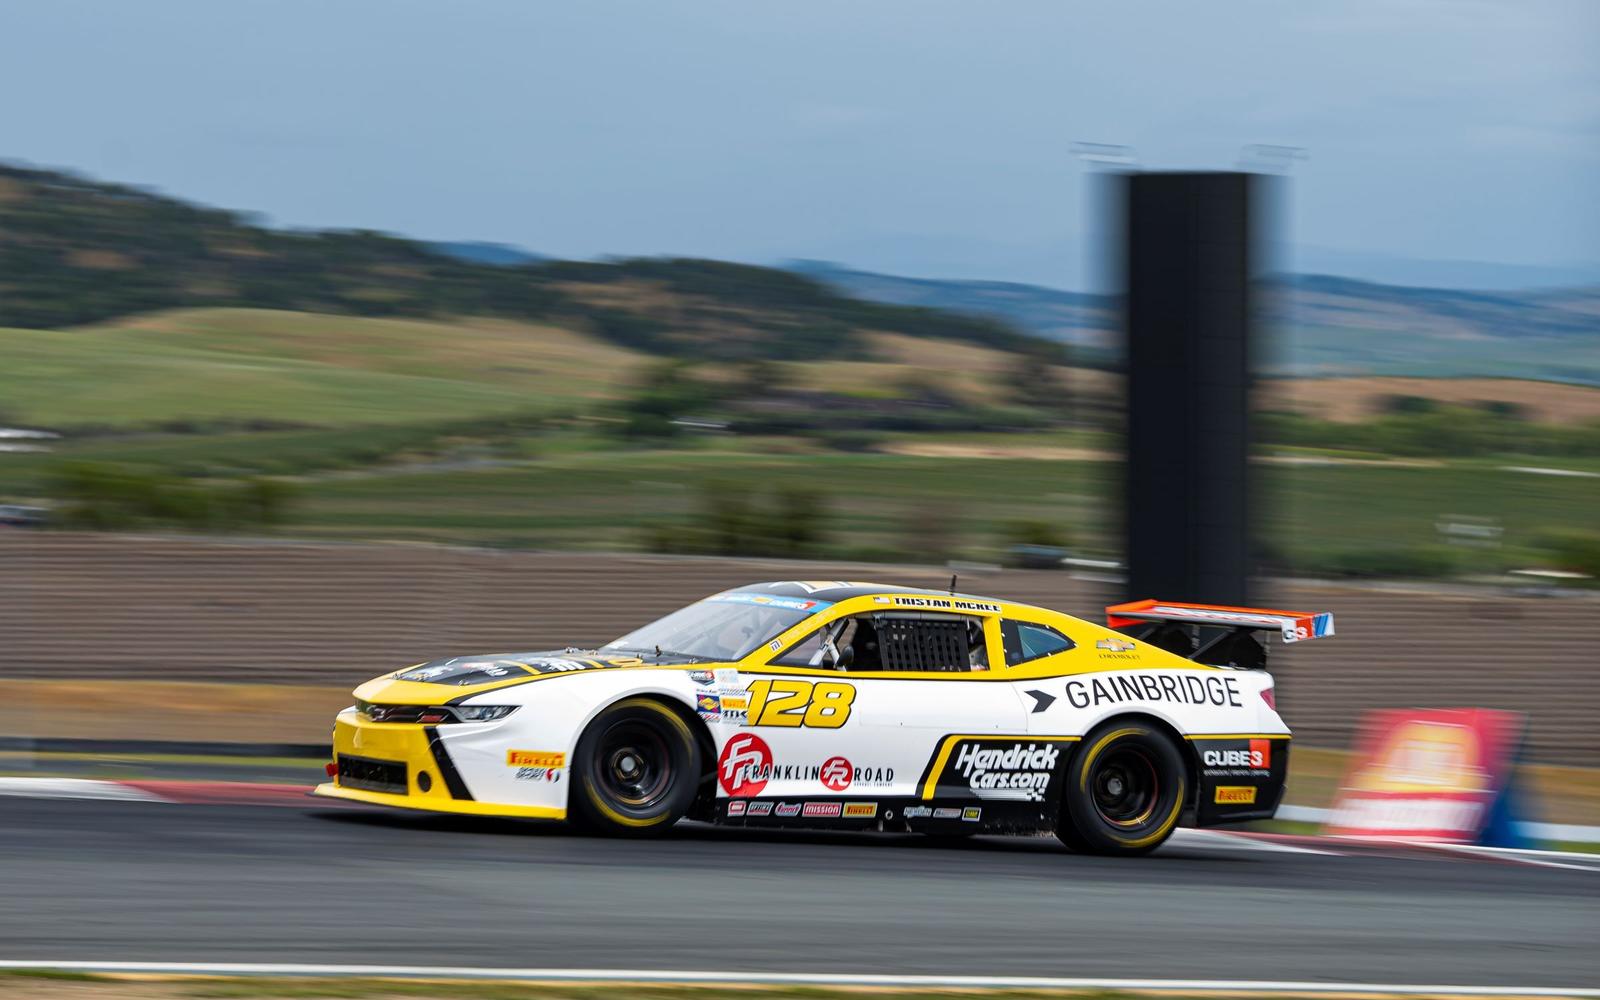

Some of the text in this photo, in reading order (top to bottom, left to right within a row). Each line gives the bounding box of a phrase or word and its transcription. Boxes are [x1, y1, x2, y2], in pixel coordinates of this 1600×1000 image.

[894, 597, 951, 608] TRISTAN
[745, 679, 857, 729] 128
[1065, 674, 1244, 709] GAINBRIDGE
[743, 764, 819, 781] FRANKLIN
[853, 767, 894, 782] ROAD
[955, 743, 1060, 778] Hendrick
[969, 768, 1051, 789] Cars.com
